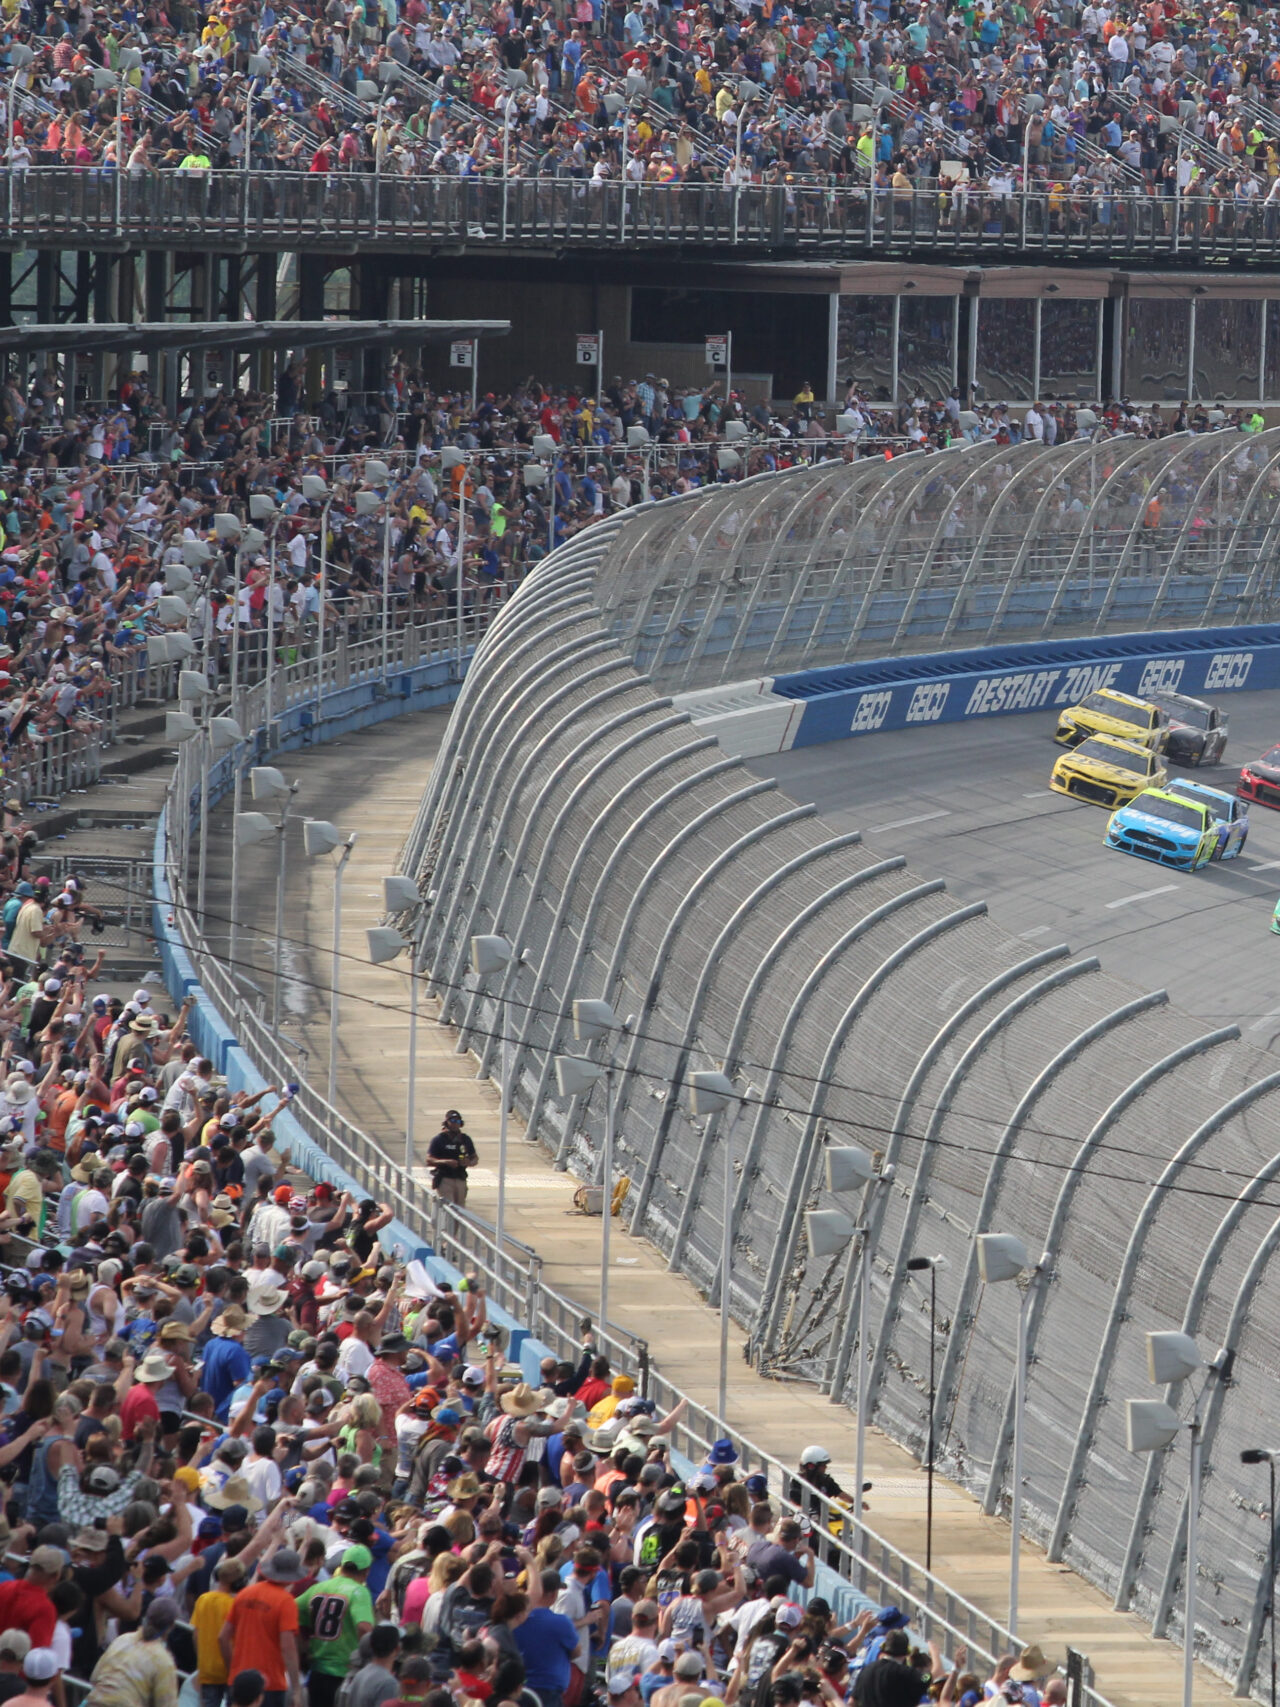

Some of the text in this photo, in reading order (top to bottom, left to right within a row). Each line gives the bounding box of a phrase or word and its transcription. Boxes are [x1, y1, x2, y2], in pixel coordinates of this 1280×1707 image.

[457, 353, 466, 364] E
[582, 351, 592, 362] D
[711, 352, 721, 363] C
[964, 663, 1123, 715] RESTART ZONE
[1138, 659, 1186, 696] GEICO
[1204, 653, 1254, 690] GEICO
[850, 690, 893, 732] GEICO
[905, 683, 950, 722] GEICO
[310, 1594, 348, 1640] 18
